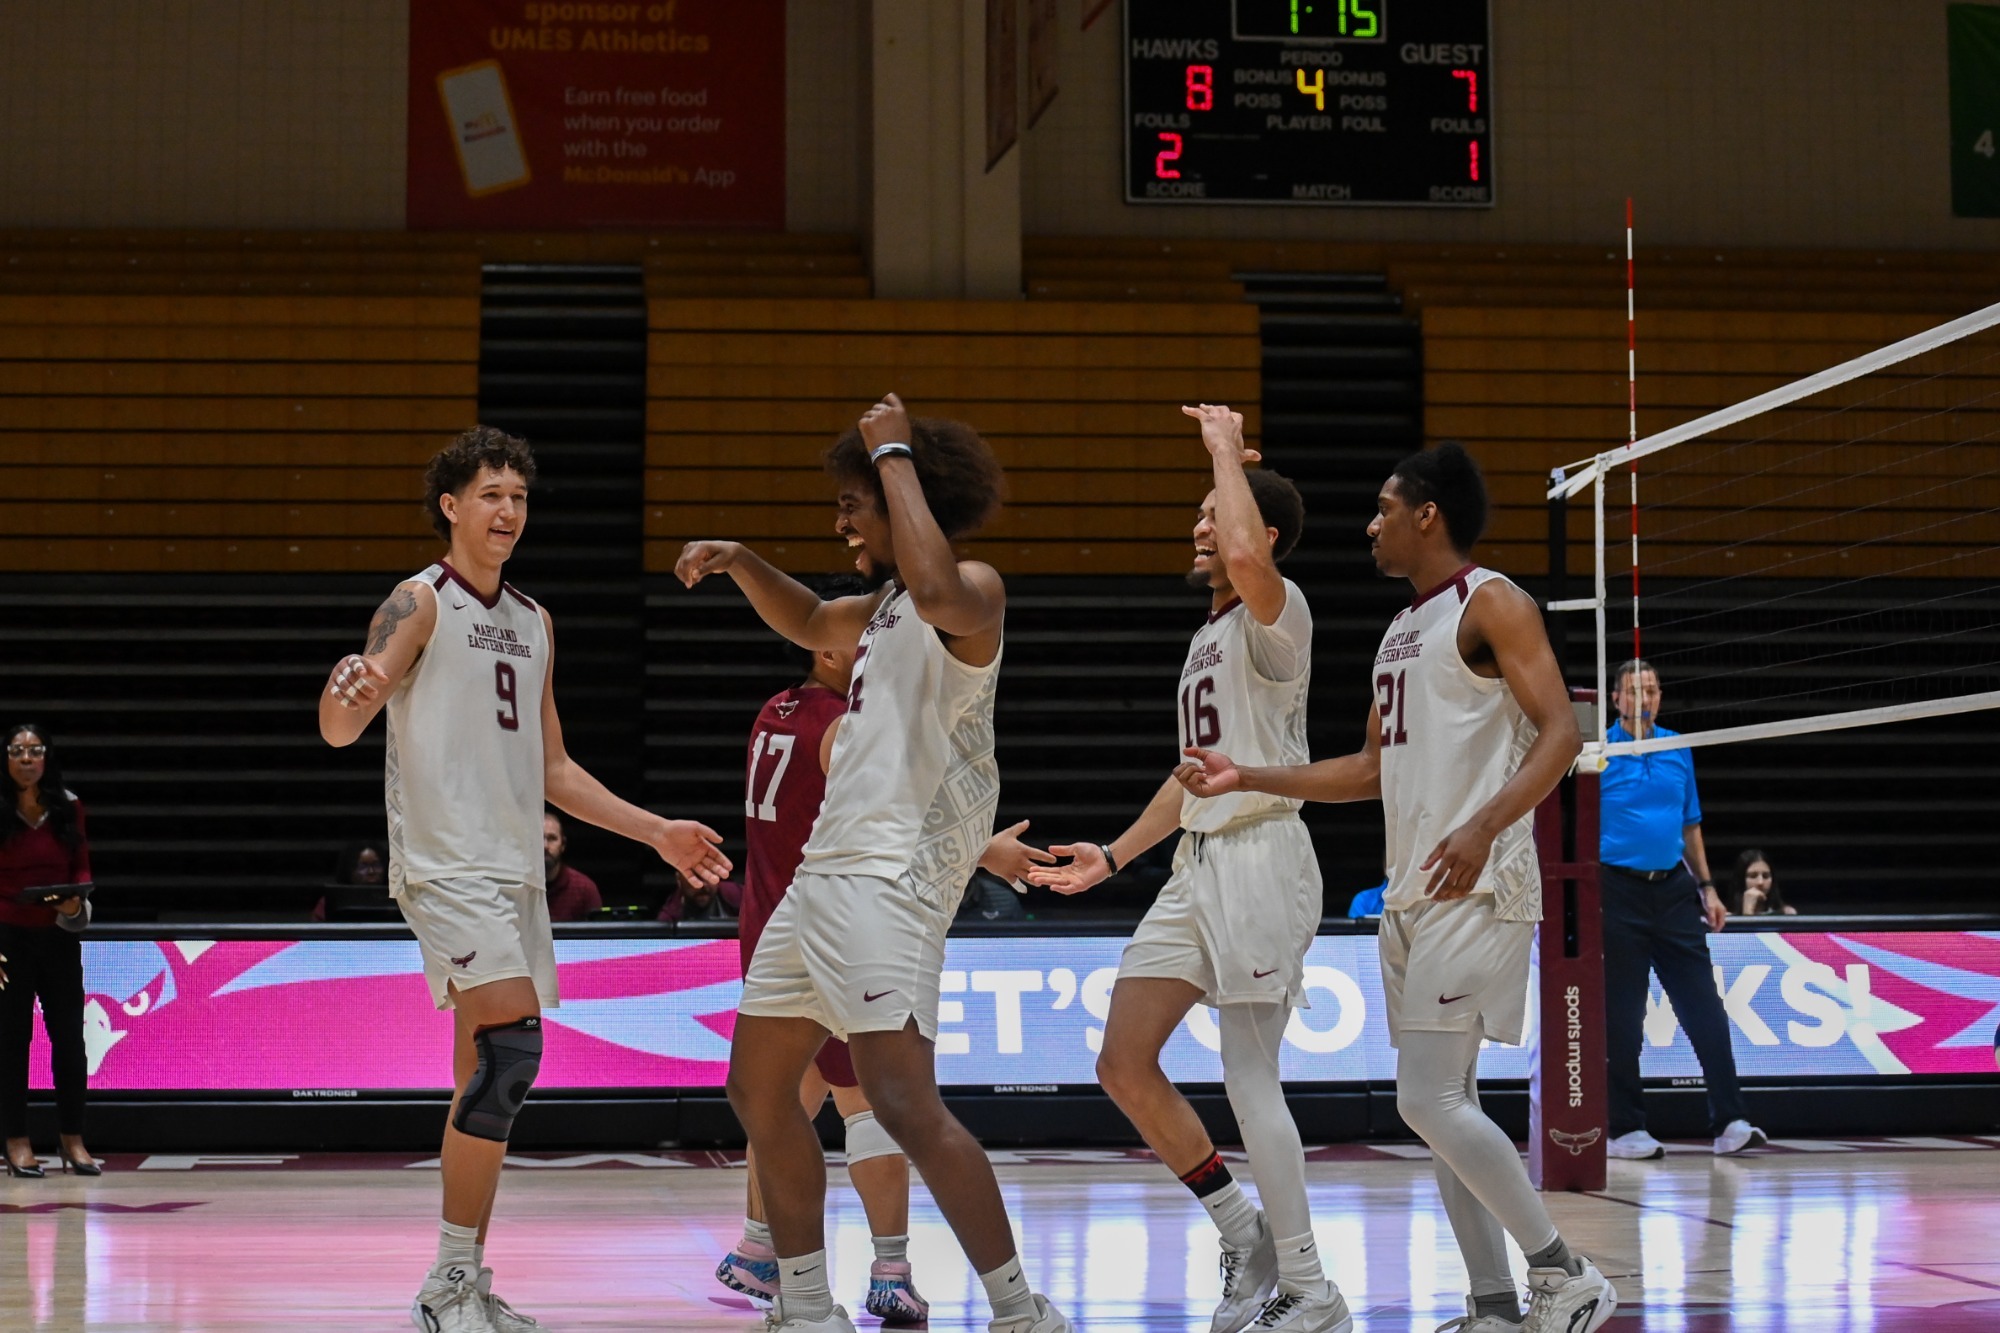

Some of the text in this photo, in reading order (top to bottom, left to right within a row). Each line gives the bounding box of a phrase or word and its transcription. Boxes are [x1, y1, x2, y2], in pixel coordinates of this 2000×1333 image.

[525, 0, 677, 25] sponsor of
[489, 26, 711, 52] UMES Athletics
[1133, 39, 1219, 60] HAWKS
[1280, 51, 1343, 66] PERIOD
[1401, 43, 1484, 65] GUEST
[1186, 64, 1213, 111] 8
[1233, 69, 1293, 85] BONUS
[1328, 70, 1387, 87] BONUS
[564, 86, 708, 106] Earn free food
[1296, 69, 1324, 111] 4
[1452, 69, 1477, 112] 7
[1234, 93, 1282, 109] POSS
[1339, 94, 1387, 111] POSS
[564, 113, 722, 136] when you order
[1134, 112, 1190, 129] FOULS
[1266, 115, 1387, 132] PLAYER FOUL
[1430, 118, 1486, 134] FOULS
[564, 139, 648, 158] with the
[1973, 129, 1995, 158] 4
[1155, 132, 1183, 179] 2
[1469, 140, 1479, 181] 1
[564, 165, 736, 188] McDonald's App
[1146, 182, 1206, 198] SCORE
[1292, 185, 1351, 199] MATCH
[1429, 186, 1487, 200] SCORE
[472, 623, 518, 643] MARYLAND
[467, 635, 532, 658] EASTERN SHORE
[495, 660, 519, 732] 9
[1181, 675, 1222, 748] 16
[1376, 668, 1408, 748] 21
[745, 731, 796, 822] 17
[1564, 985, 1584, 1108] sports imports
[292, 1089, 358, 1098] DAKTRONICS
[993, 1085, 1059, 1093] DAKTRONICS
